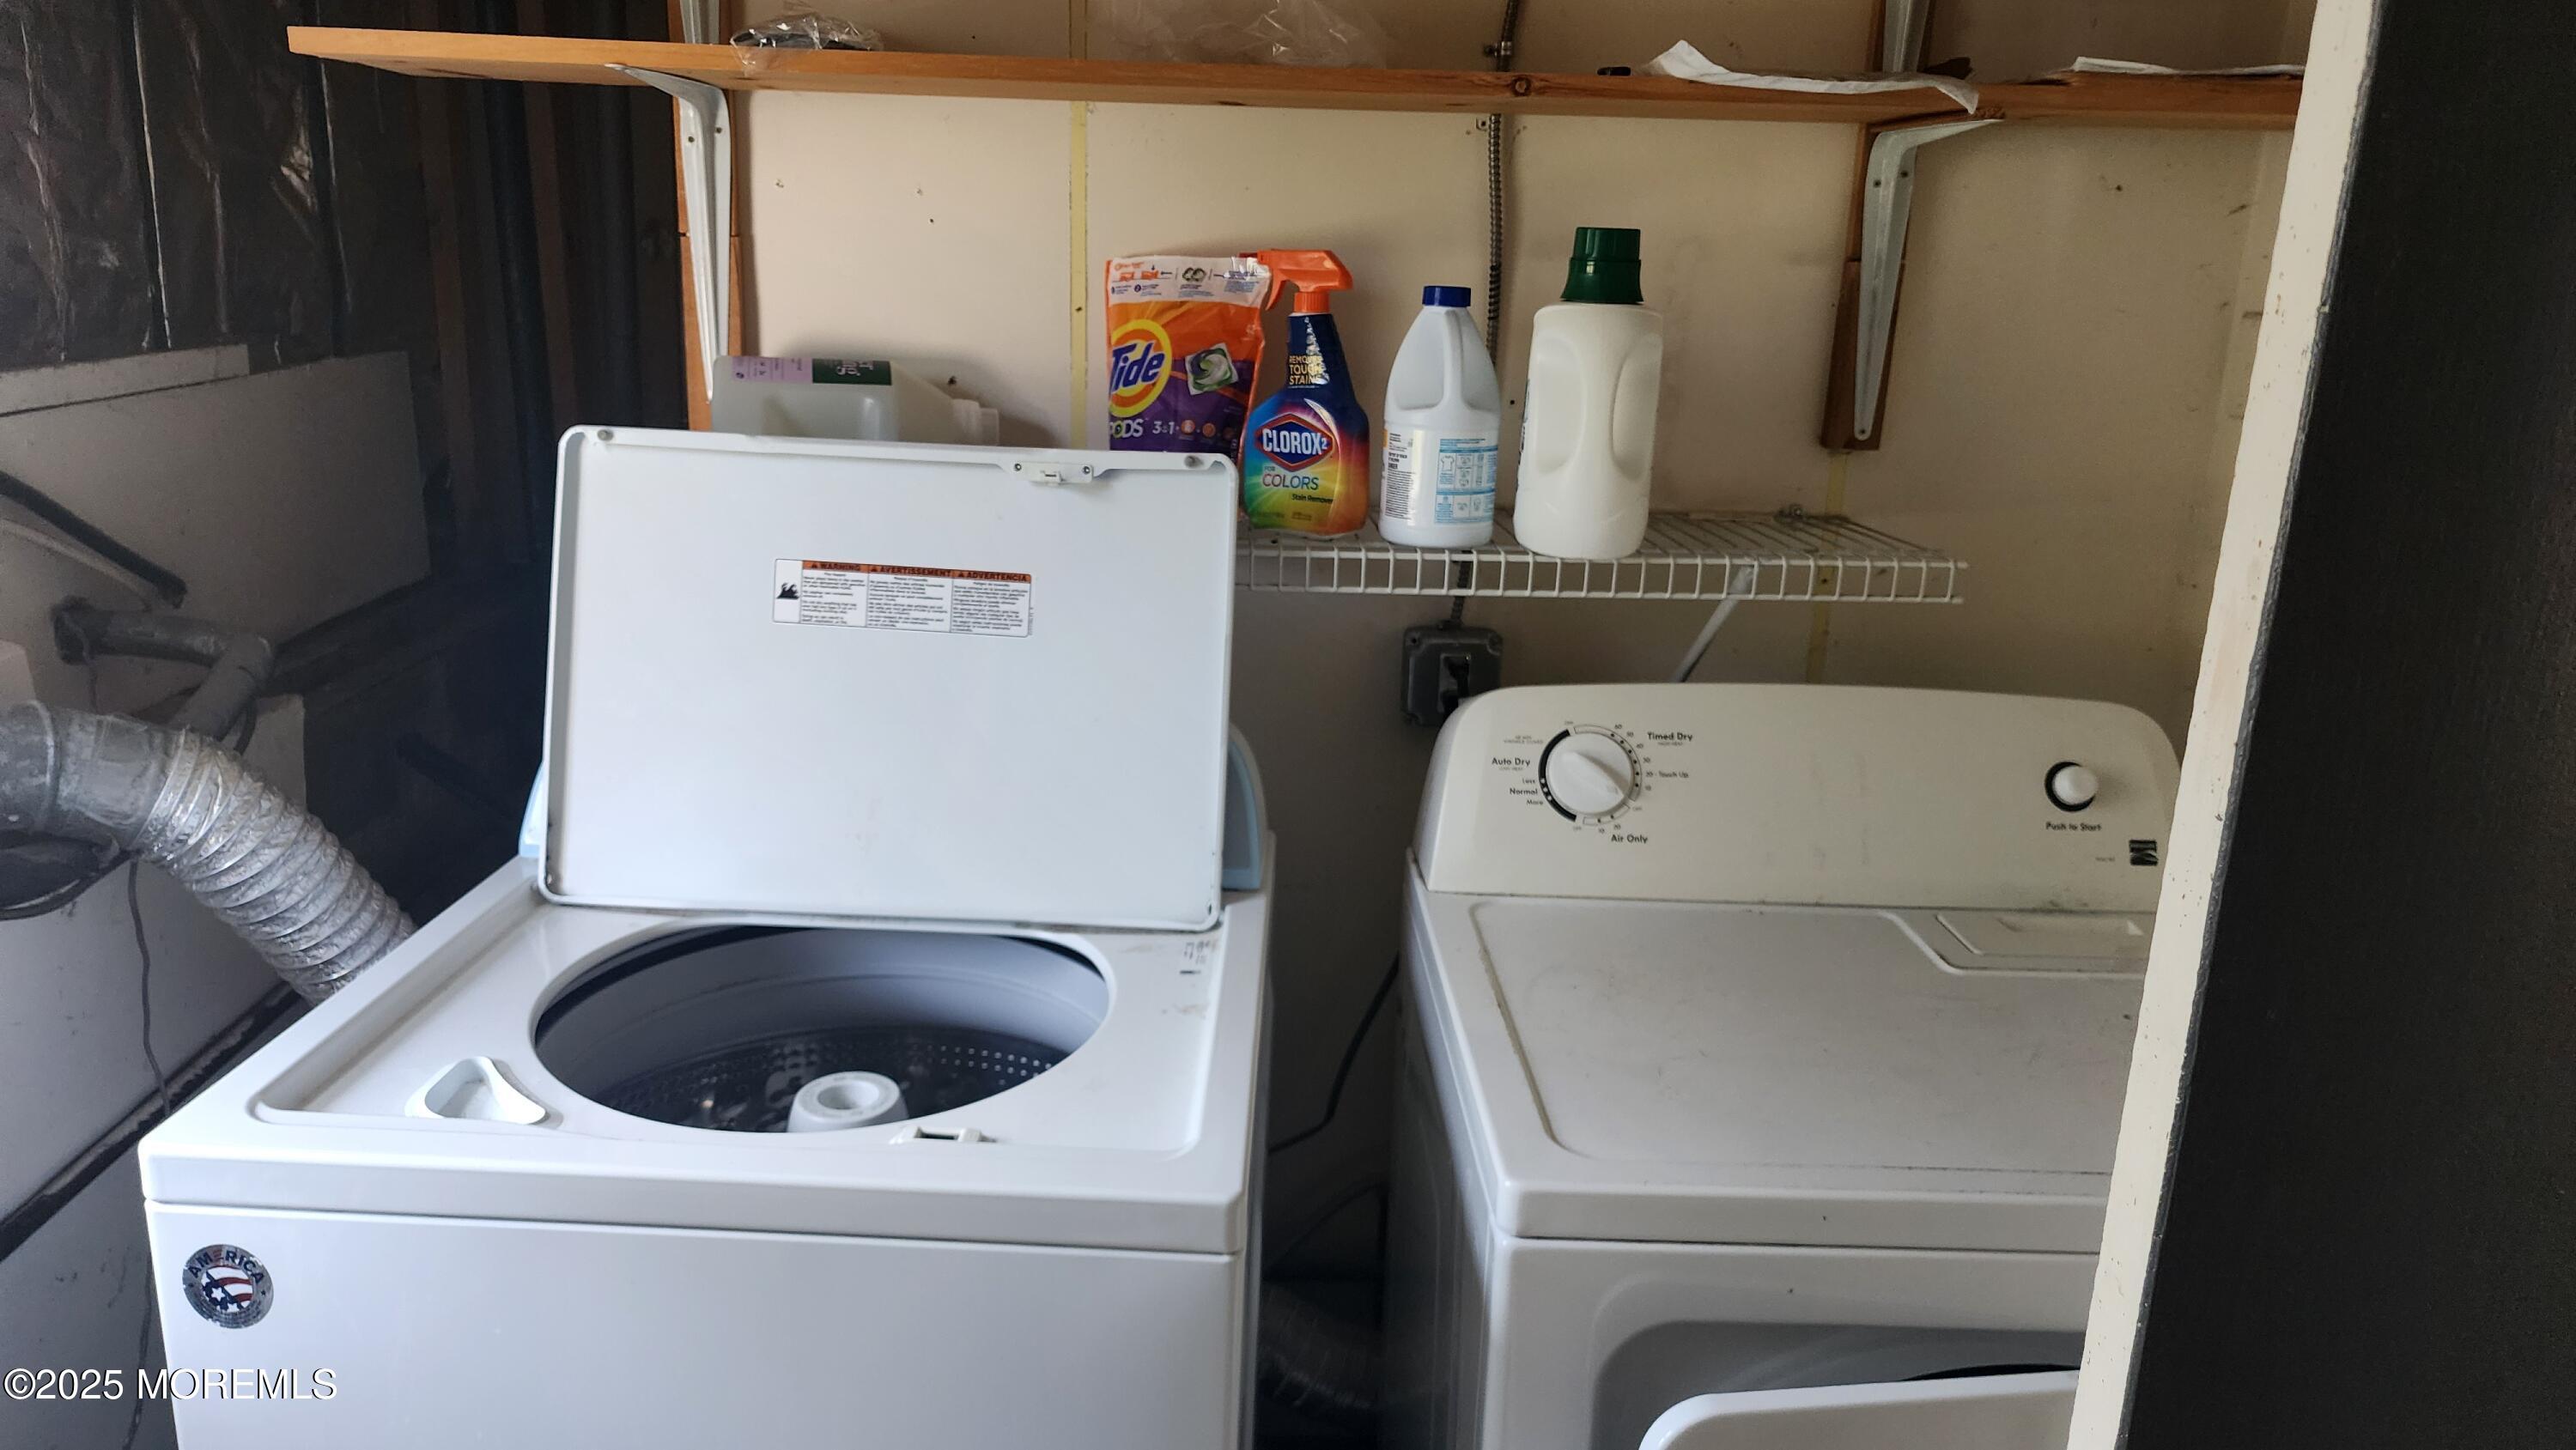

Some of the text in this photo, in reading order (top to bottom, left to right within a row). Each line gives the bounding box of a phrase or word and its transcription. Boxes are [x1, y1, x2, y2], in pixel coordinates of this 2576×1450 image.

[1111, 343, 1165, 392] Tide
[1262, 473, 1319, 490] COLORS
[820, 562, 860, 572] WARNING
[967, 571, 1028, 582] ADVERTENCIA
[1648, 732, 1693, 742] Timed Dry
[1492, 757, 1531, 767] Auto Dry
[2045, 822, 2102, 832] Push to Start
[1627, 834, 1649, 844] Only
[189, 1250, 264, 1283] AMERICA
